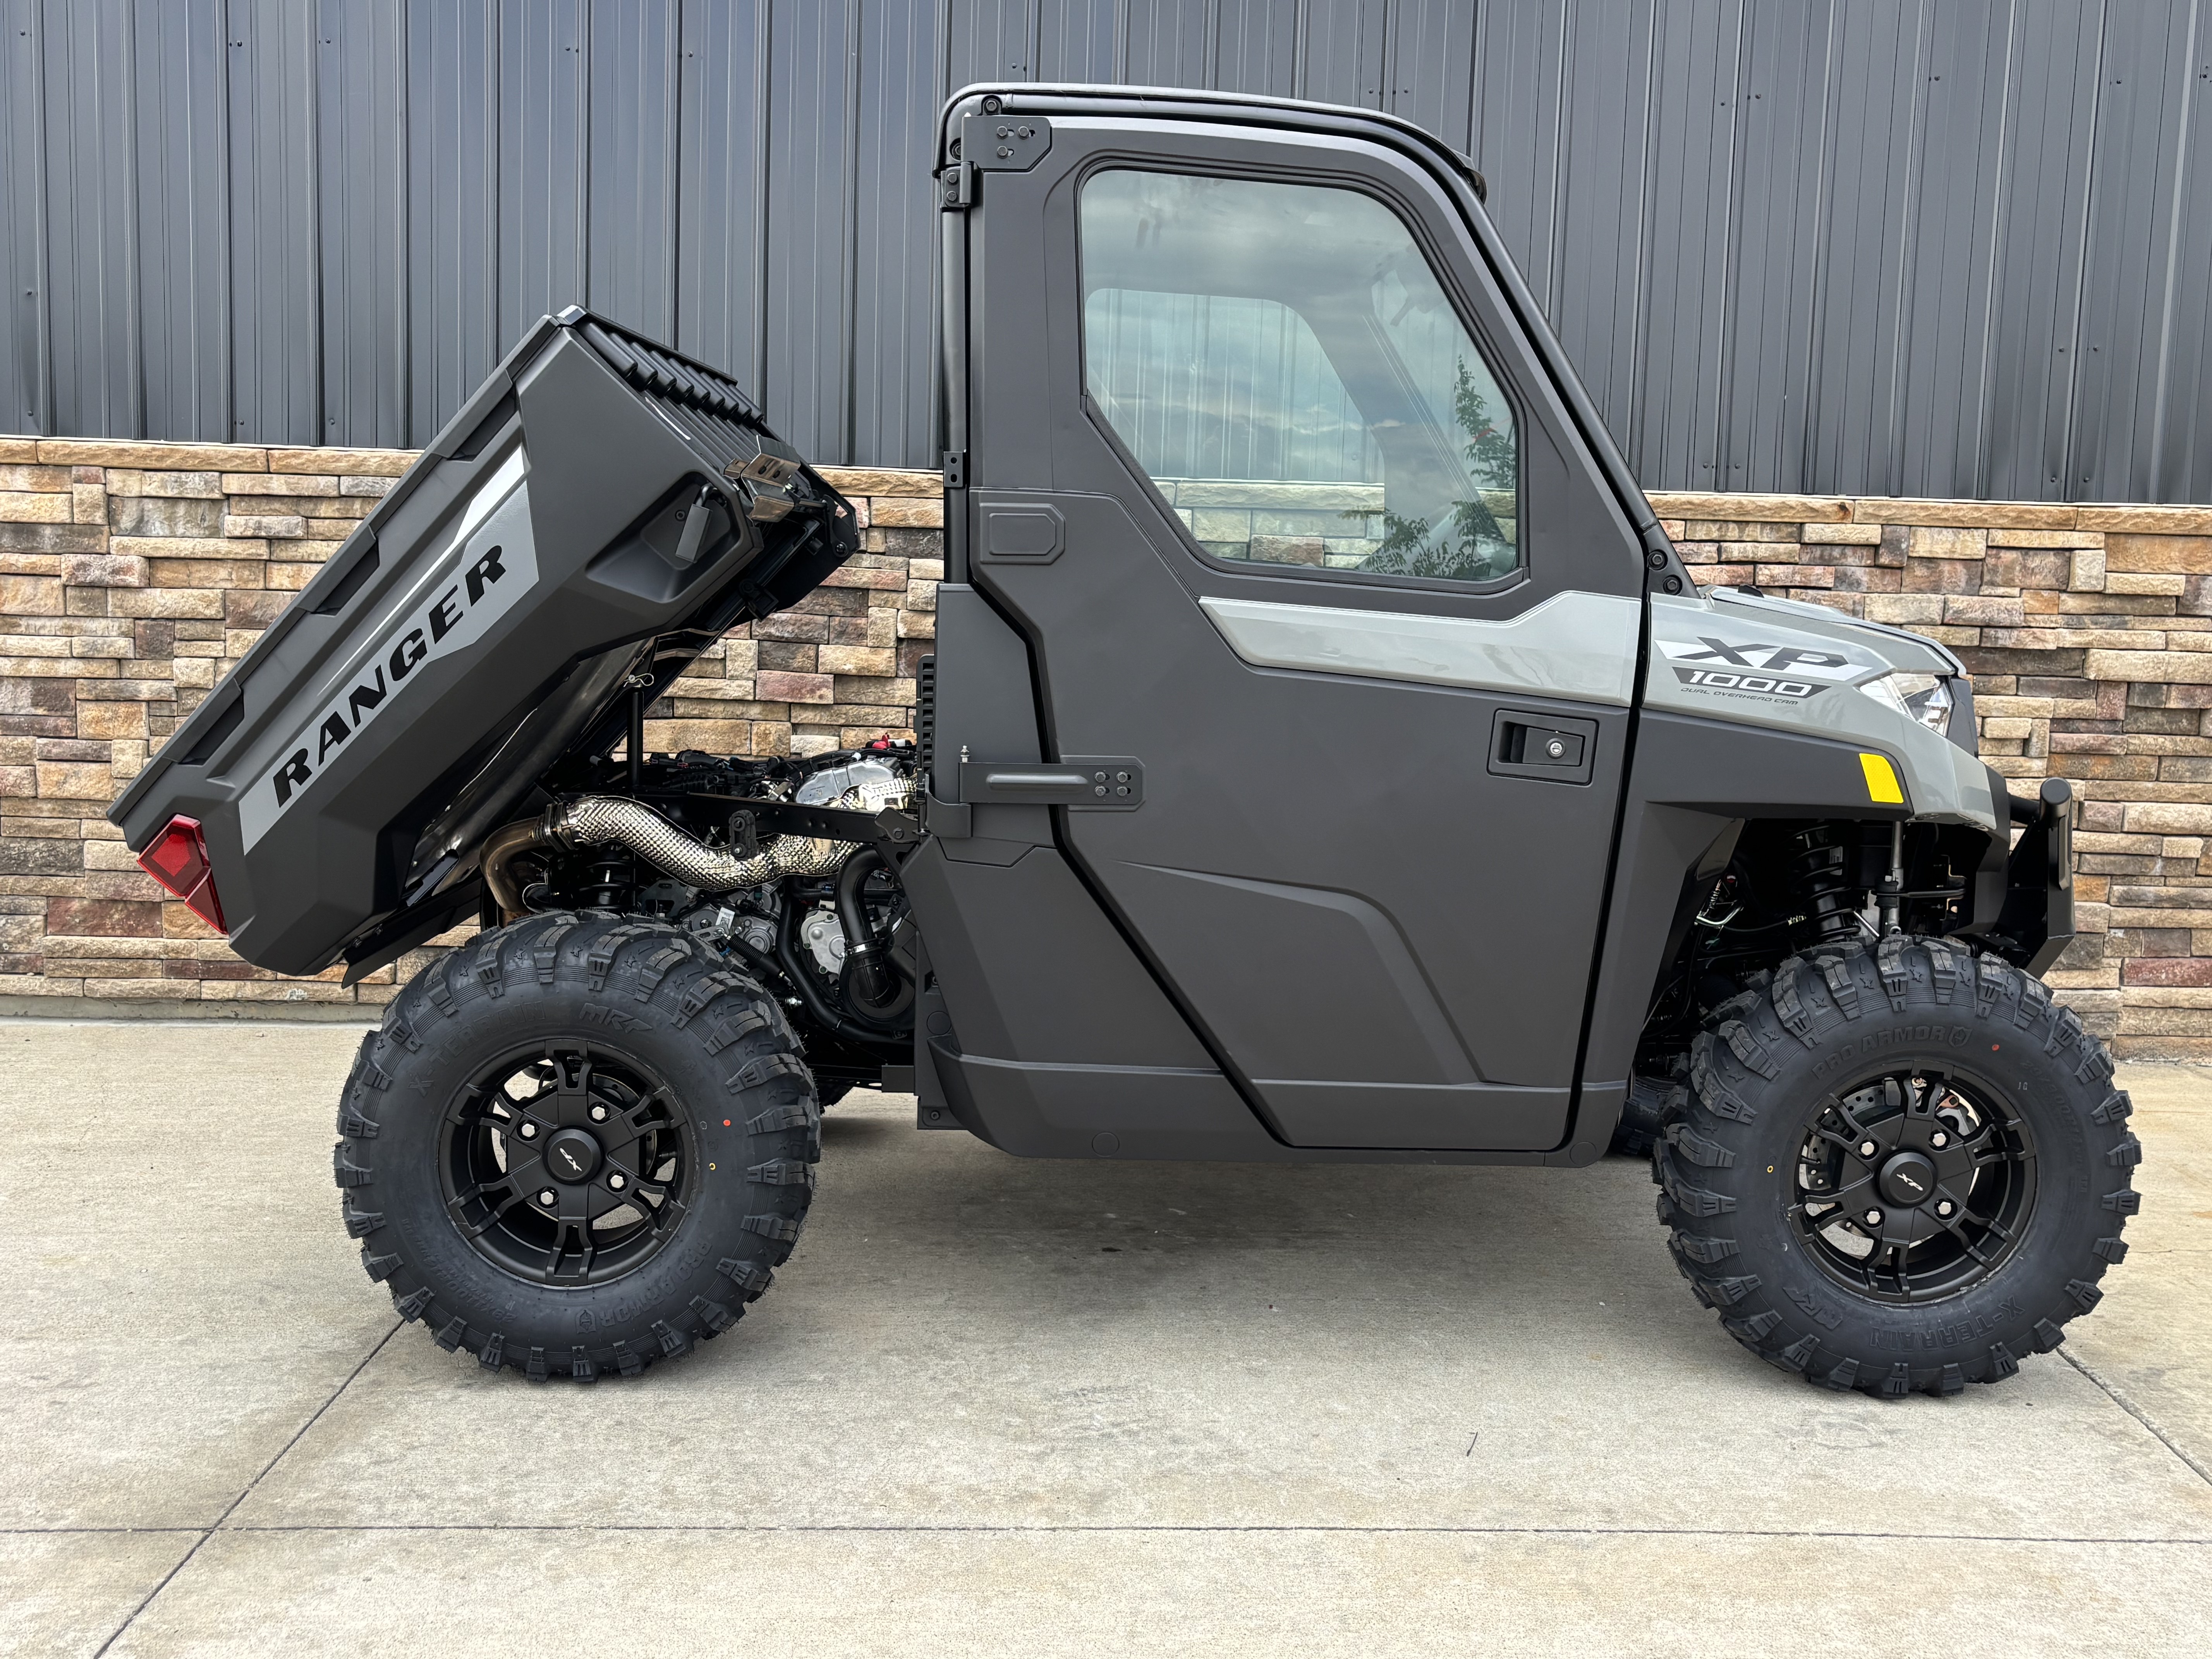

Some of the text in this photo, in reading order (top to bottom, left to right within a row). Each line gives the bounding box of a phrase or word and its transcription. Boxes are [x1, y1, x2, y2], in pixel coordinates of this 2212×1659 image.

[1671, 636, 1849, 671] XP
[273, 545, 506, 808] RANGER
[1689, 671, 1812, 697] 1000
[1713, 691, 1772, 702] OVERHEAD
[1812, 1025, 1946, 1080] PRO ARMOR
[560, 1147, 582, 1171] XP
[1896, 1173, 1923, 1191] XP
[1870, 1296, 2025, 1352] X-TERRAIN
